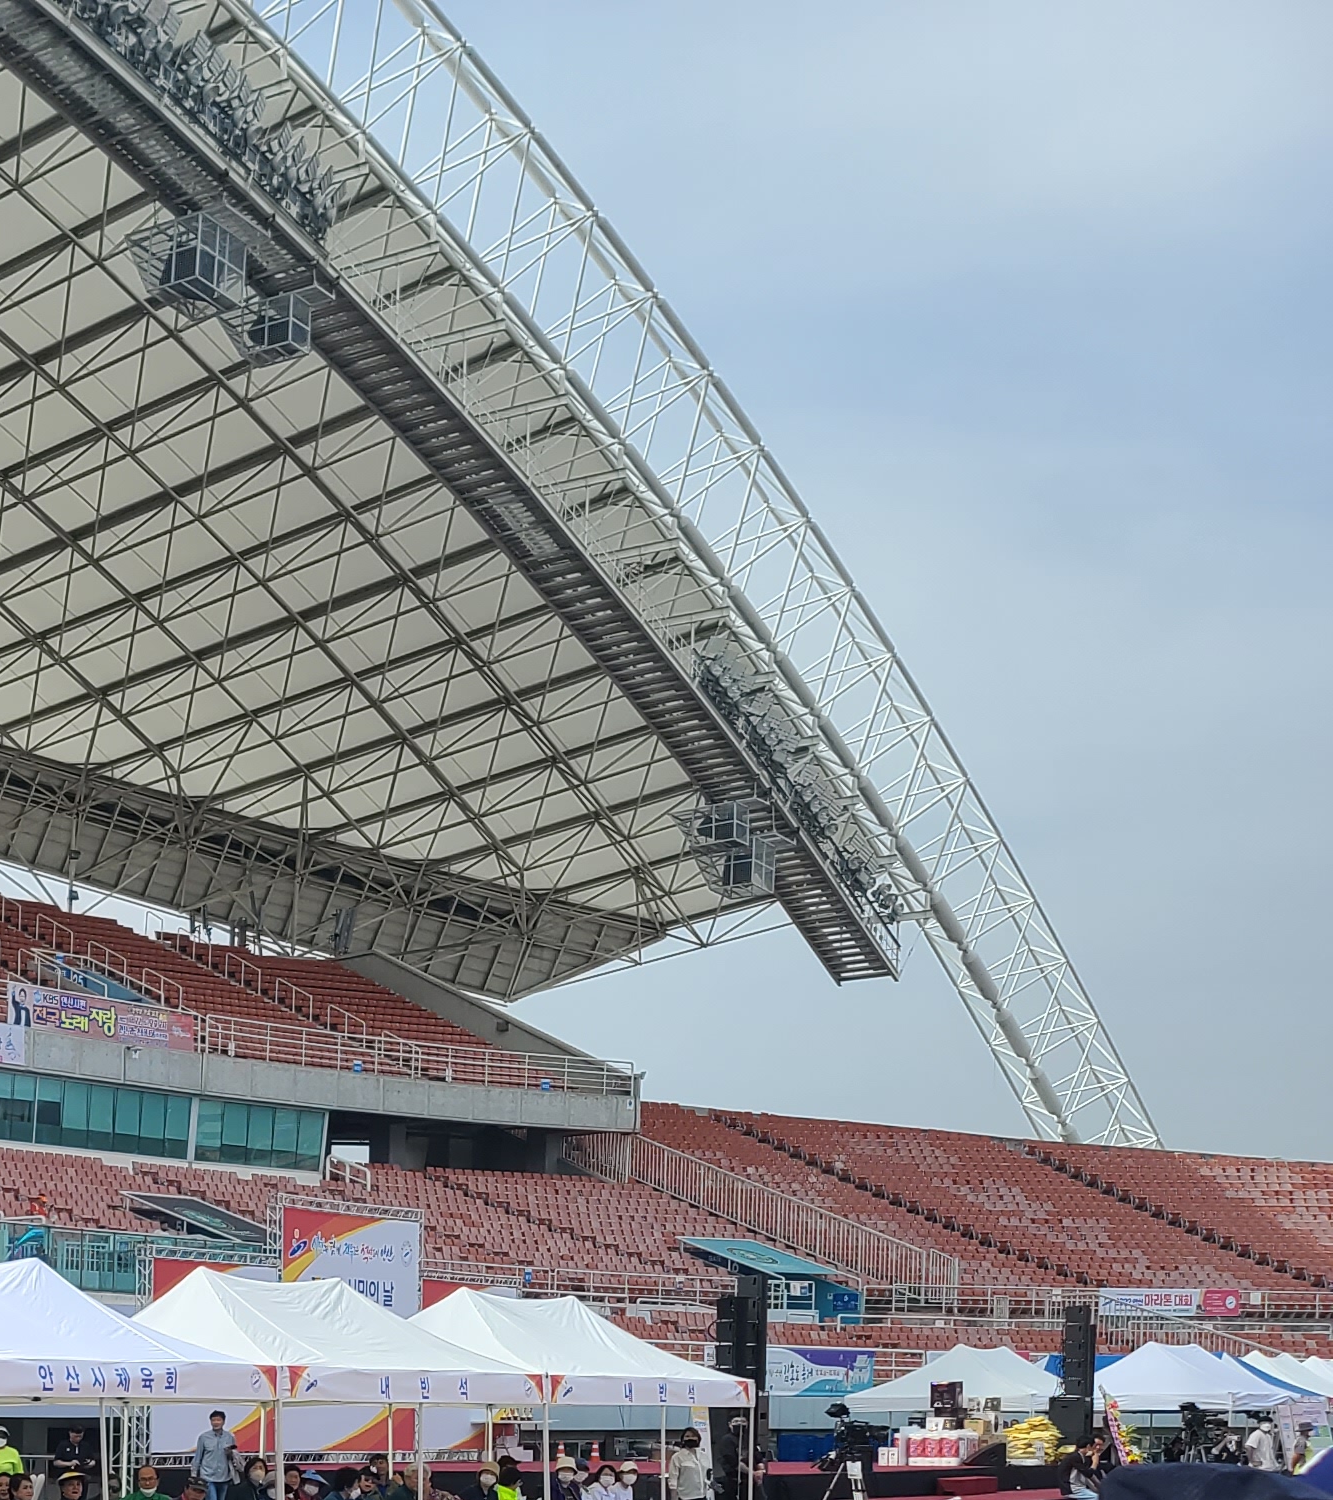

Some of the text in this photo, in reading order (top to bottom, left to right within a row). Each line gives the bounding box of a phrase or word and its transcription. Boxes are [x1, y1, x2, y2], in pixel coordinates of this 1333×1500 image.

[42, 993, 59, 1005] KBS
[383, 1281, 395, 1308] 날
[843, 1294, 849, 1302] 6
[1144, 1293, 1172, 1307] 마라톤
[1174, 1293, 1193, 1307] 대회
[37, 1364, 178, 1394] 안산시체육회
